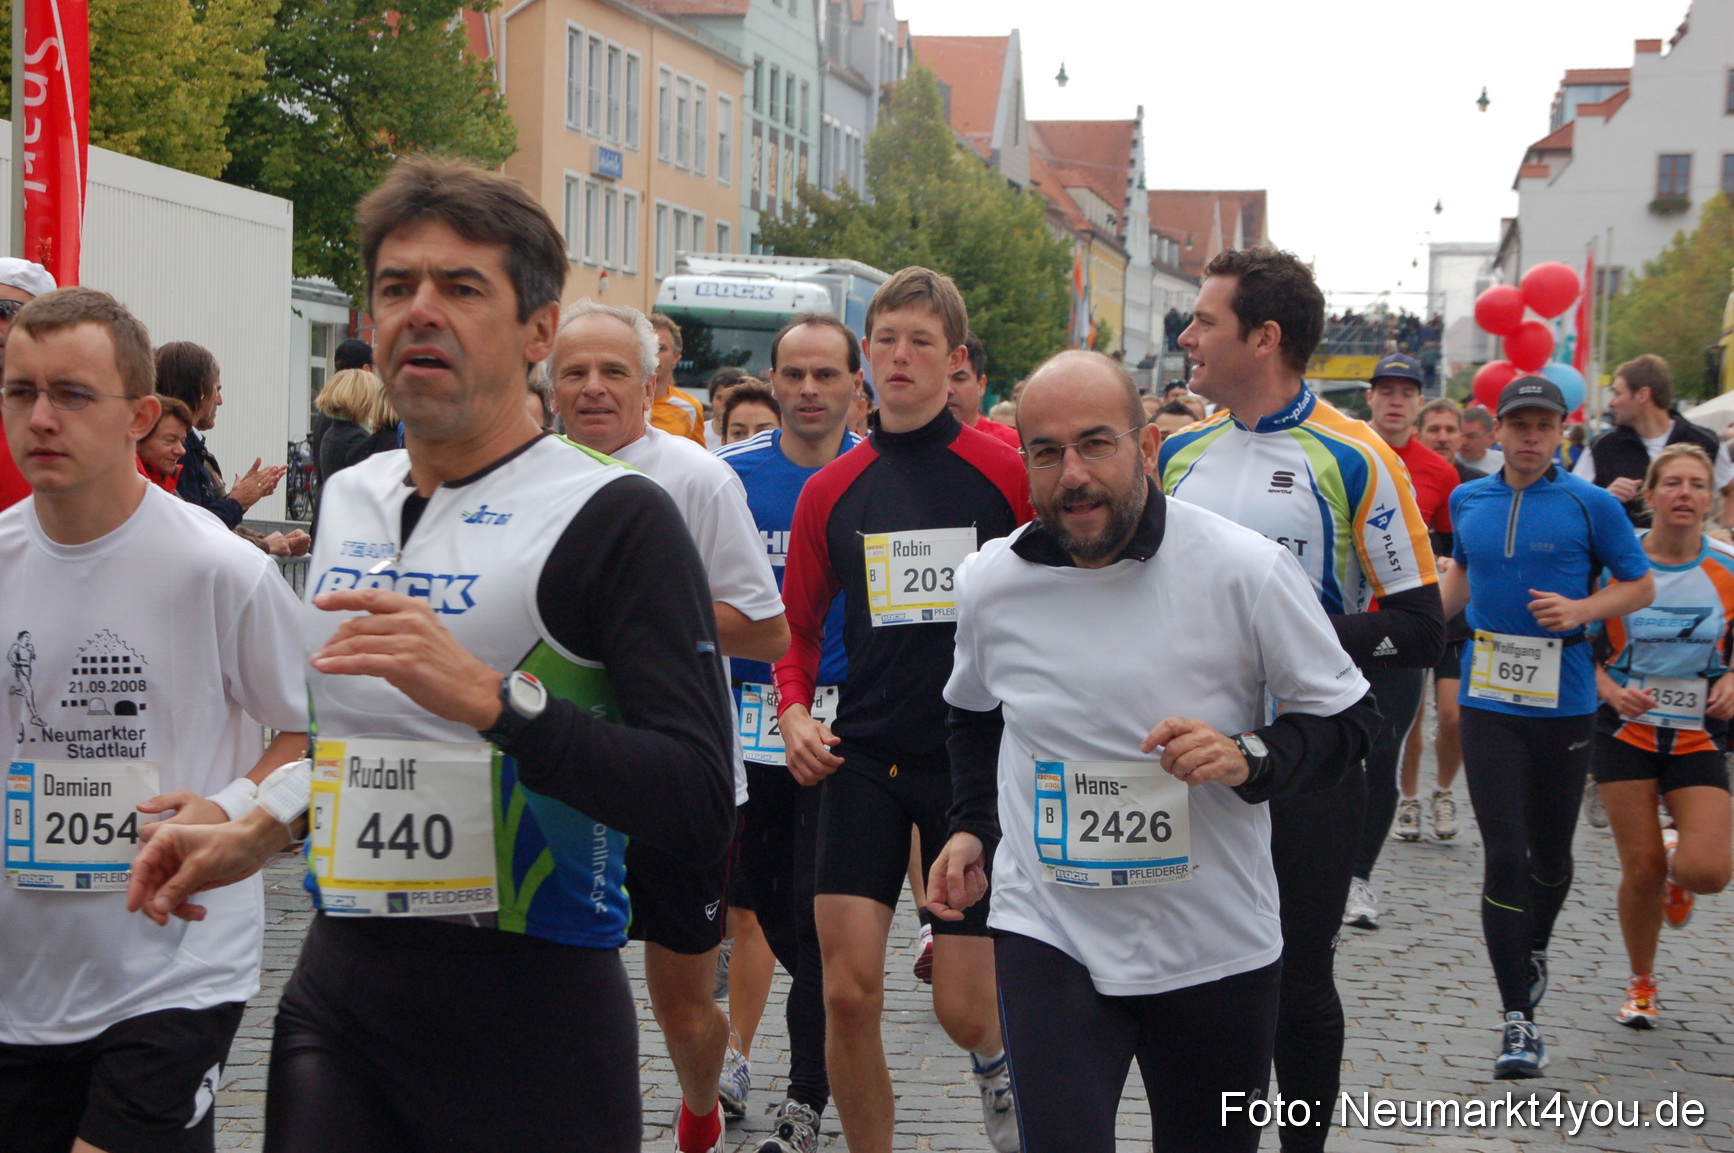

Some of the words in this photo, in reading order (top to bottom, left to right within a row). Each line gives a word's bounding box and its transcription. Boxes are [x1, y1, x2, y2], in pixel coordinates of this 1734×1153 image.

[695, 282, 775, 300] BOCK
[893, 540, 931, 557] Robin
[1383, 533, 1402, 572] PLAST
[870, 569, 876, 582] B
[903, 567, 955, 593] 203
[1373, 648, 1398, 657] adidas
[1498, 662, 1538, 683] 697
[69, 680, 147, 694] 21.09.2008
[746, 713, 753, 724] B
[42, 725, 146, 743] Neumarkter
[67, 742, 147, 759] Stadtlauf
[349, 755, 417, 790] Rudolf
[44, 773, 112, 797] Damian
[1074, 773, 1128, 796] Hans-
[15, 808, 22, 825] B
[1045, 807, 1054, 824] B
[45, 811, 138, 845] 2054
[356, 812, 454, 860] 440
[1079, 810, 1172, 844] 2426
[1055, 869, 1089, 881] BOCK
[1129, 863, 1189, 879] PFLEIDERER
[411, 886, 494, 905] PFLEIDERER
